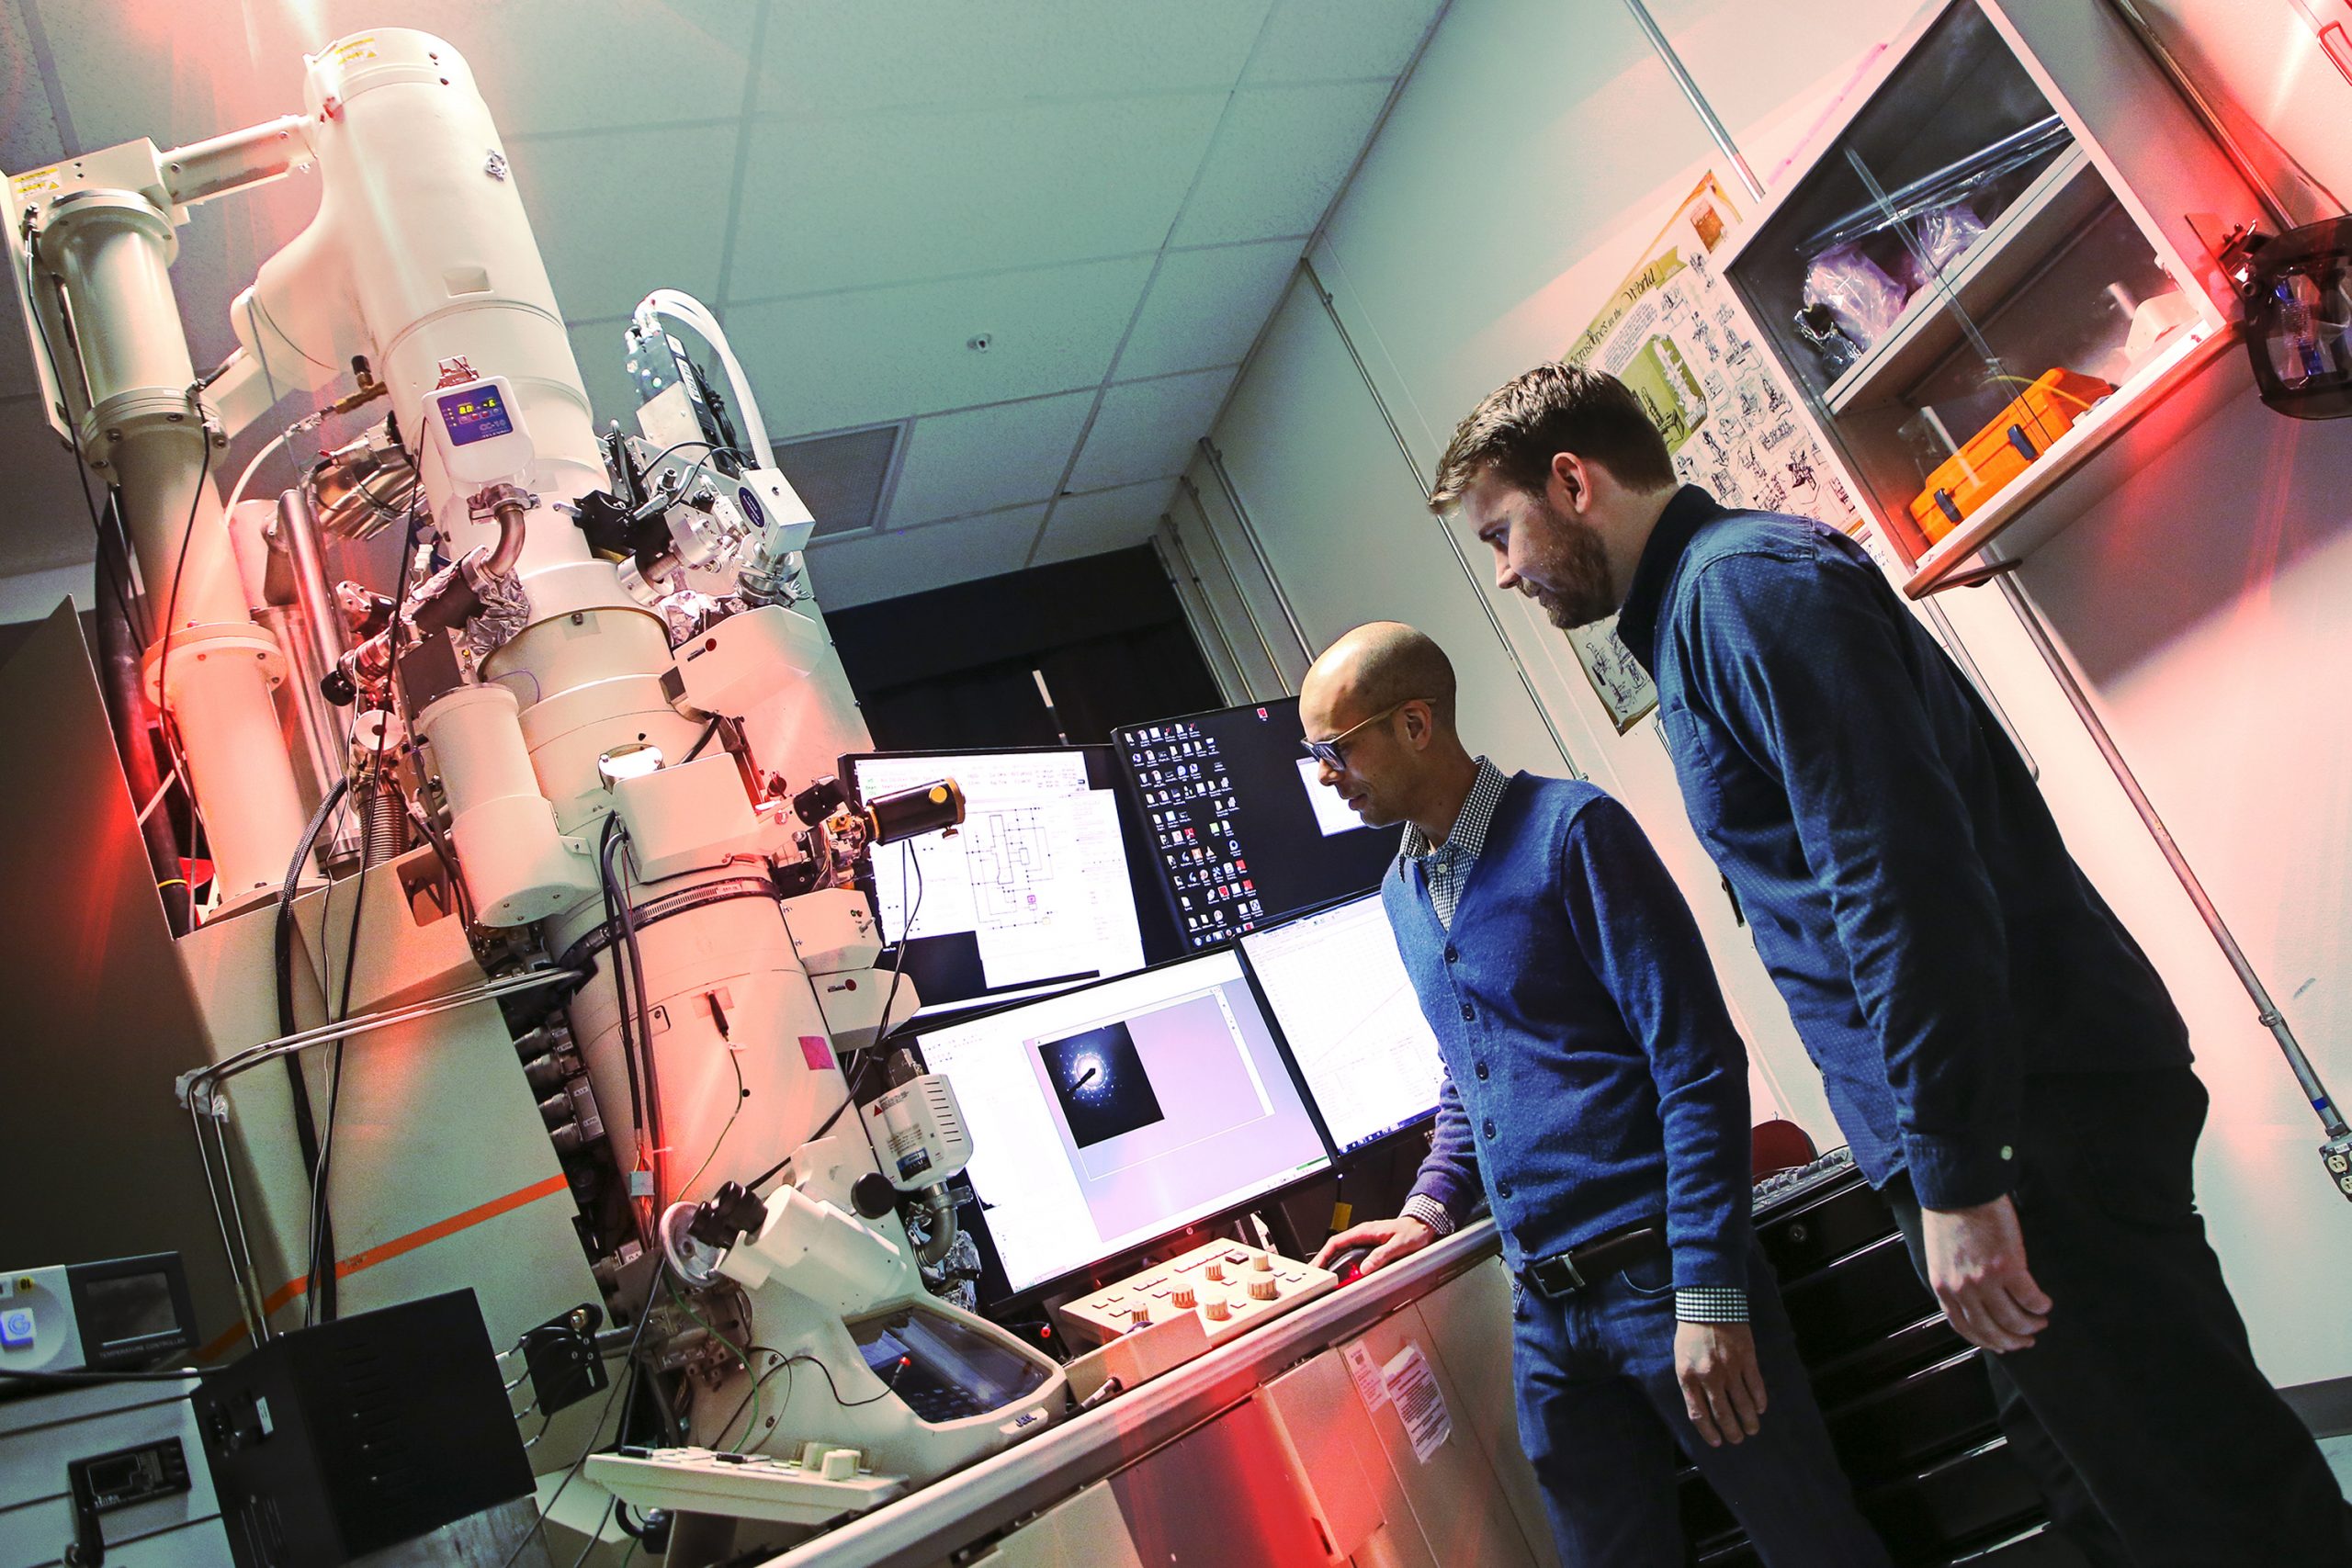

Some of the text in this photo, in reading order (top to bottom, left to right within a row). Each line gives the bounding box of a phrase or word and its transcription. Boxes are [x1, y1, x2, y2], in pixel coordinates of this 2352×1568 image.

[1621, 267, 1656, 302] World
[99, 1337, 187, 1359] TEMPERATURE CONTROLLER
